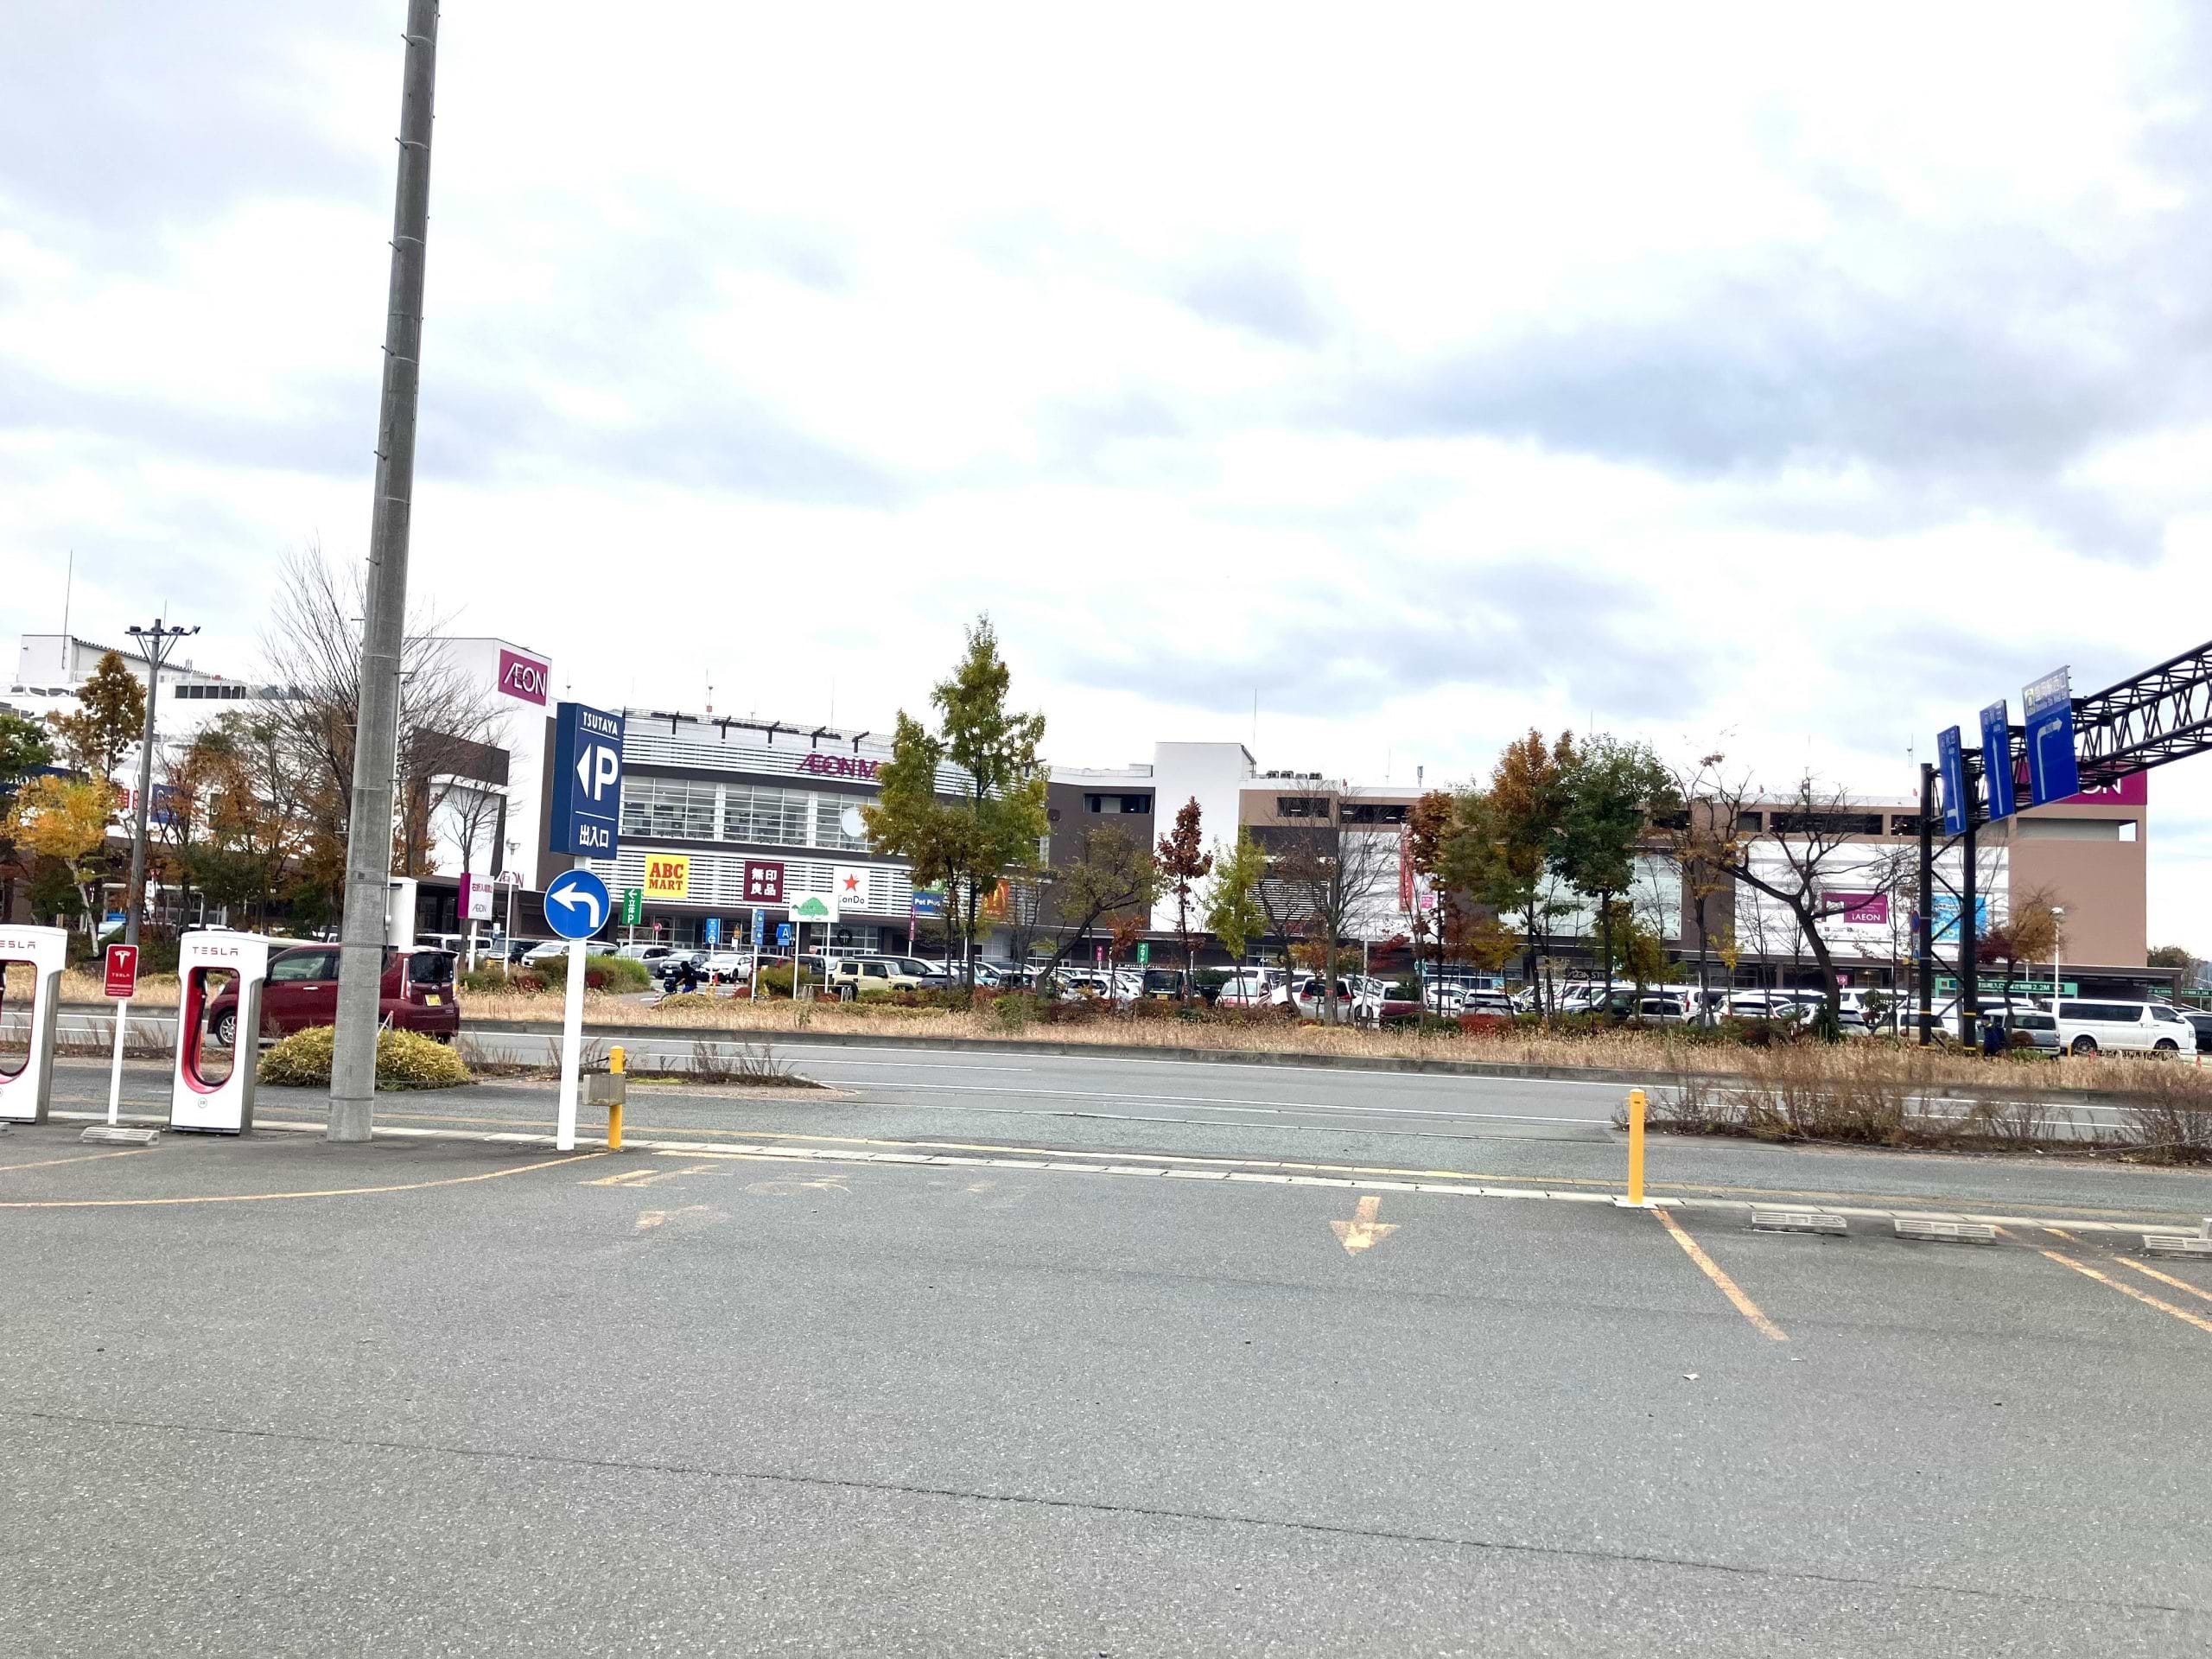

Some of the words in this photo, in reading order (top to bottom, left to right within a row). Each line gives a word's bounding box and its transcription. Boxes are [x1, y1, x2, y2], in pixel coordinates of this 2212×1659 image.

[582, 712, 618, 735] TSUTAYA
[594, 745, 619, 801] P
[579, 823, 609, 849] 出入口
[649, 861, 684, 879] ABC
[751, 868, 778, 881] 無印
[648, 879, 683, 891] MART
[750, 881, 777, 896] 良品
[839, 895, 865, 905] anDo
[914, 898, 926, 906] Pet
[781, 927, 790, 938] A
[0, 939, 35, 950] ESLA
[192, 946, 238, 957] TESLA
